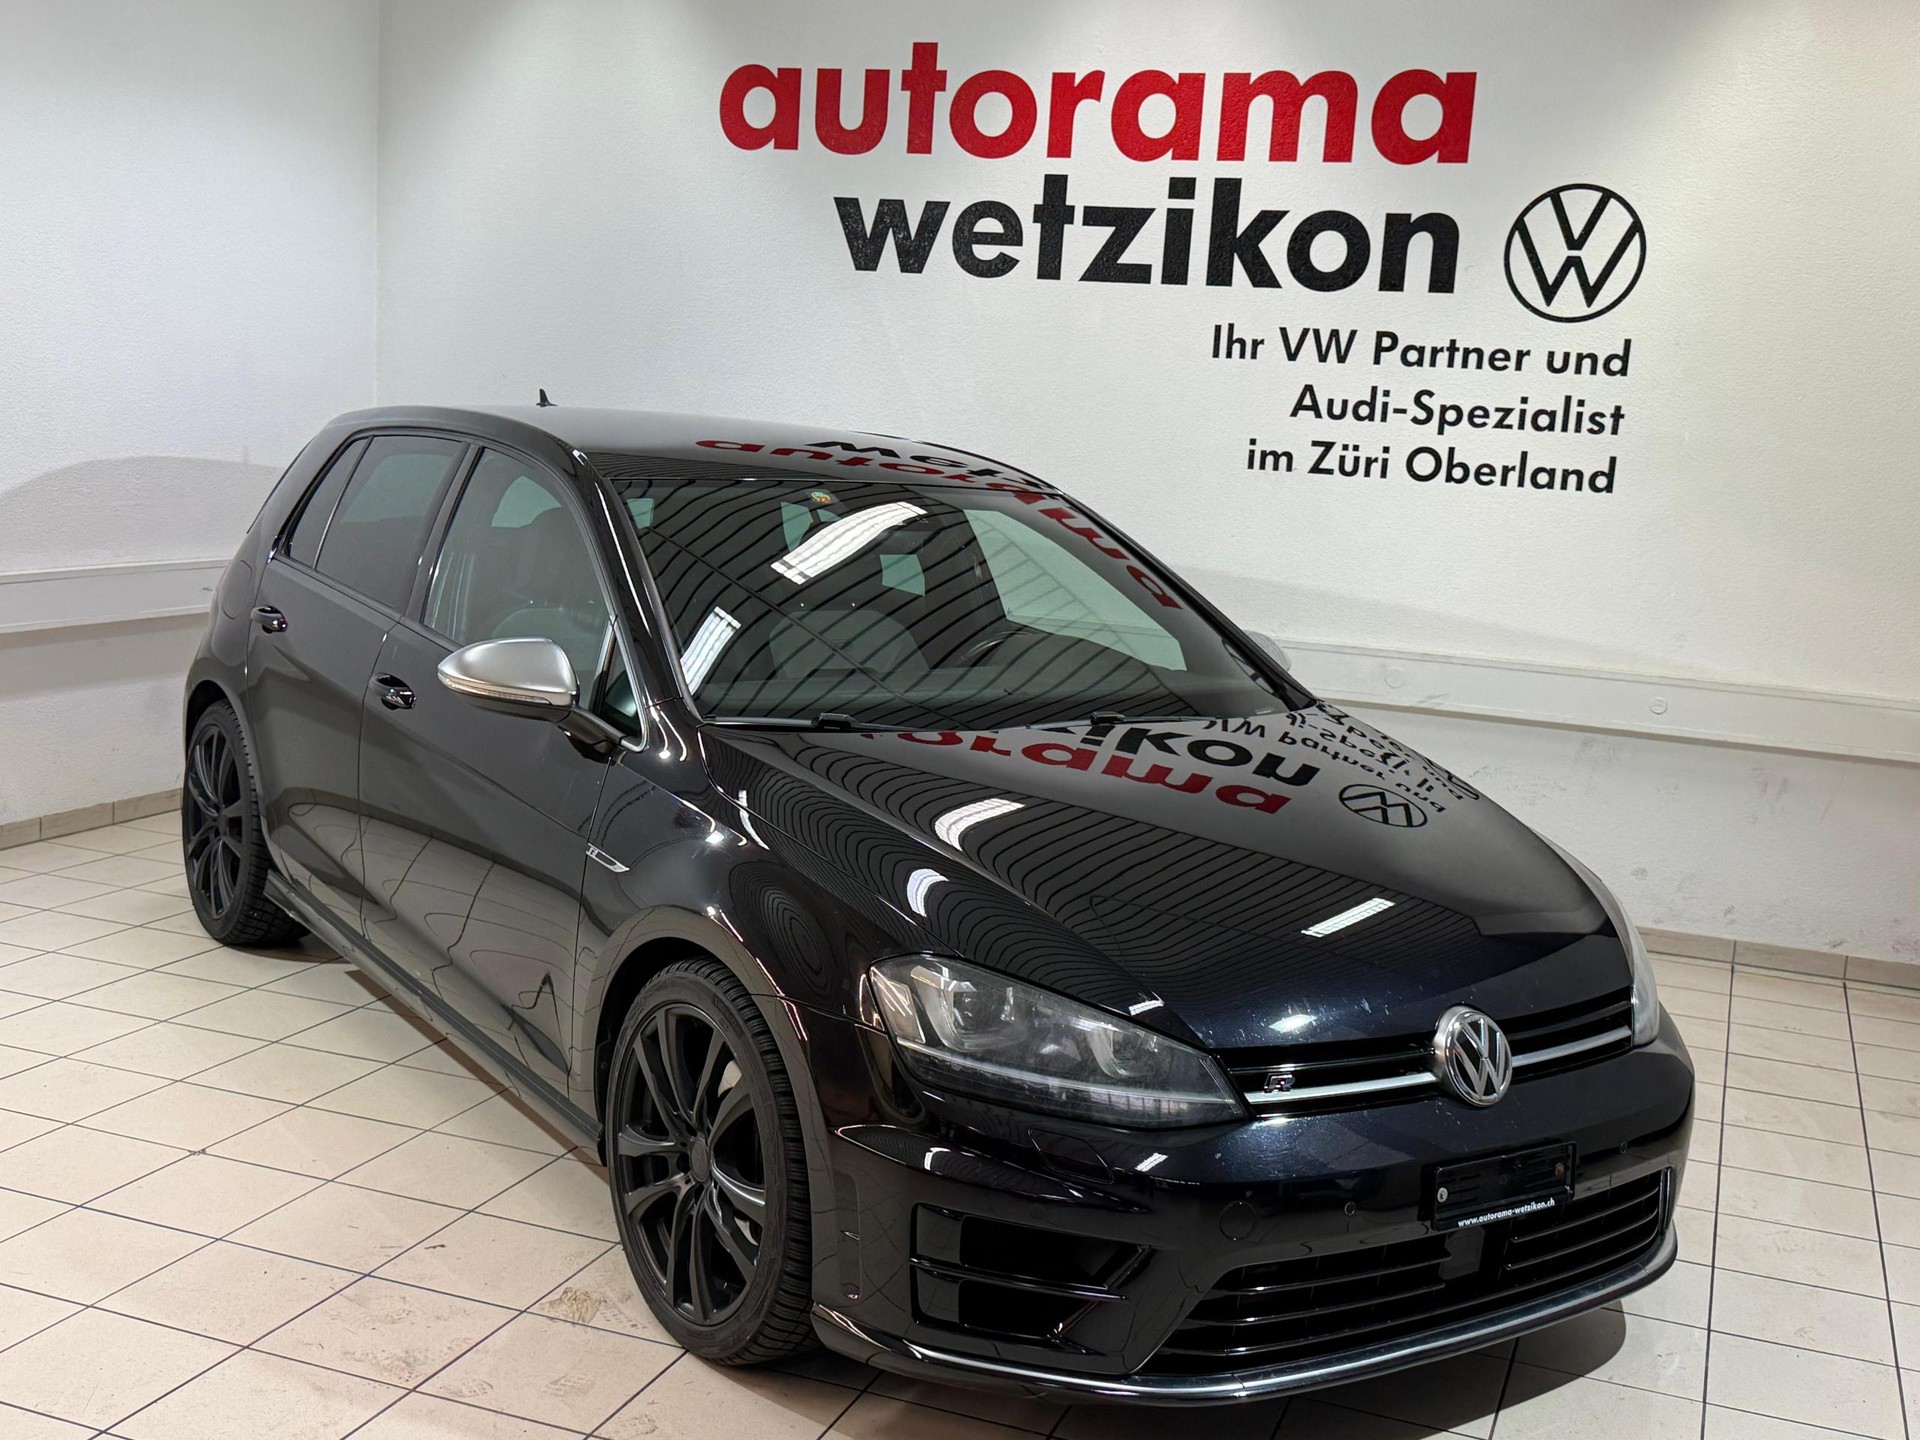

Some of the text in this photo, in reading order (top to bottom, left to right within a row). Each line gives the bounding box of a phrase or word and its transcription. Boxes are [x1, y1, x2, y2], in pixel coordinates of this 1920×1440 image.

[720, 42, 1478, 165] autorama
[834, 174, 1460, 294] wetzikon
[1212, 323, 1632, 377] Ihr VW Partner und
[1289, 384, 1625, 436] Audi-Spezialist
[1247, 438, 1617, 494] im Züri Oberland
[1457, 1197, 1556, 1227] www.autorama-wetzikon.ch
